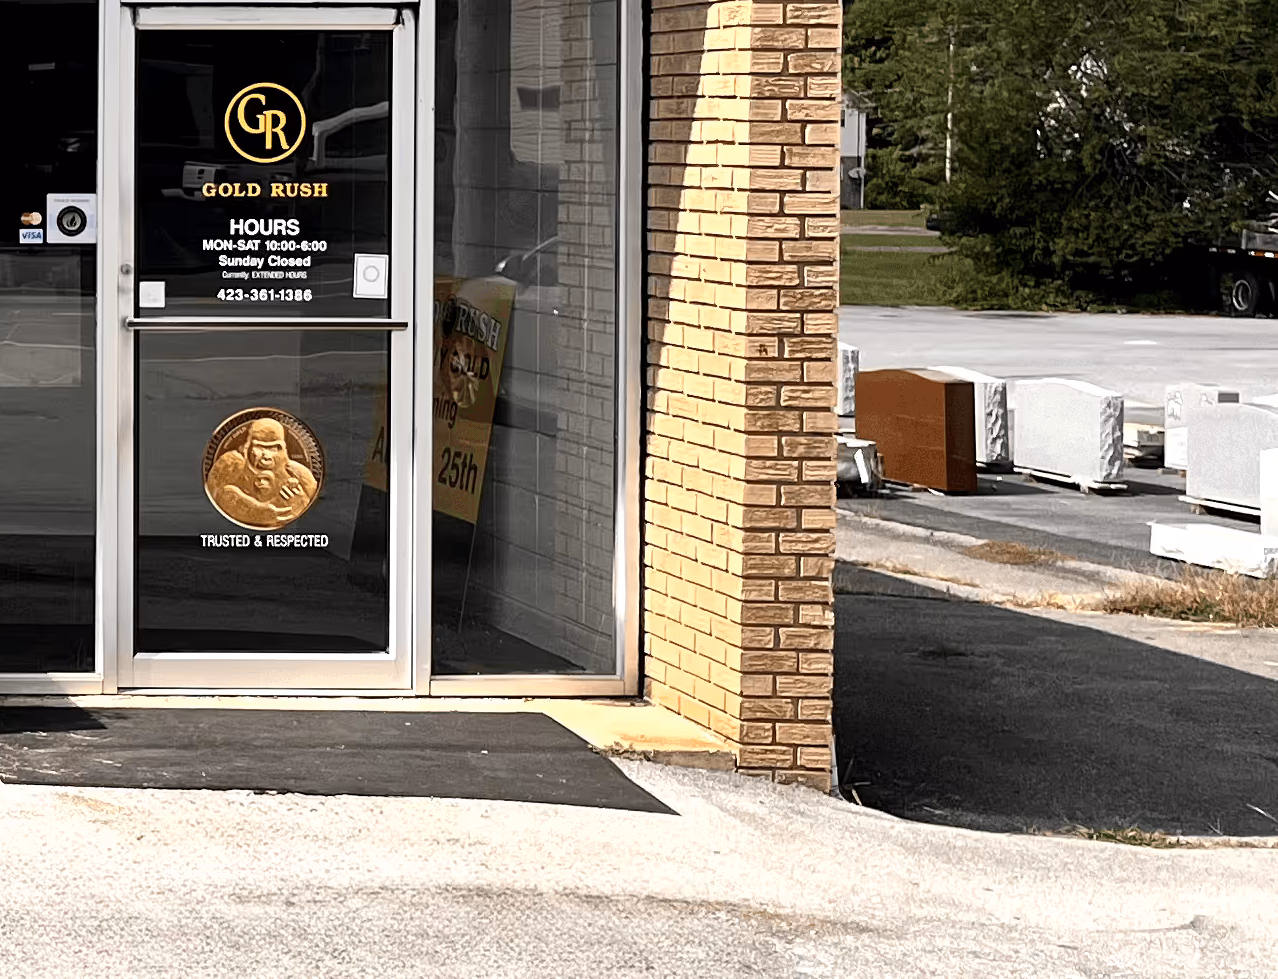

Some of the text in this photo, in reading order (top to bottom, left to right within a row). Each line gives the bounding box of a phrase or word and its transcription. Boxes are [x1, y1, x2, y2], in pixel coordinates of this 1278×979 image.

[237, 93, 289, 149] GR
[202, 182, 329, 198] GOLD RUSH
[229, 218, 301, 236] HOURS
[22, 231, 42, 240] VISA
[202, 239, 328, 251] MON-SAT 10:00-6:00
[218, 254, 312, 269] Sunday Closed
[286, 270, 308, 279] HOURS
[216, 288, 313, 302] 423-361-1386
[455, 302, 502, 352] RUSH
[437, 446, 478, 495] 25th
[200, 534, 329, 548] TRUSTED & RESPECTED
